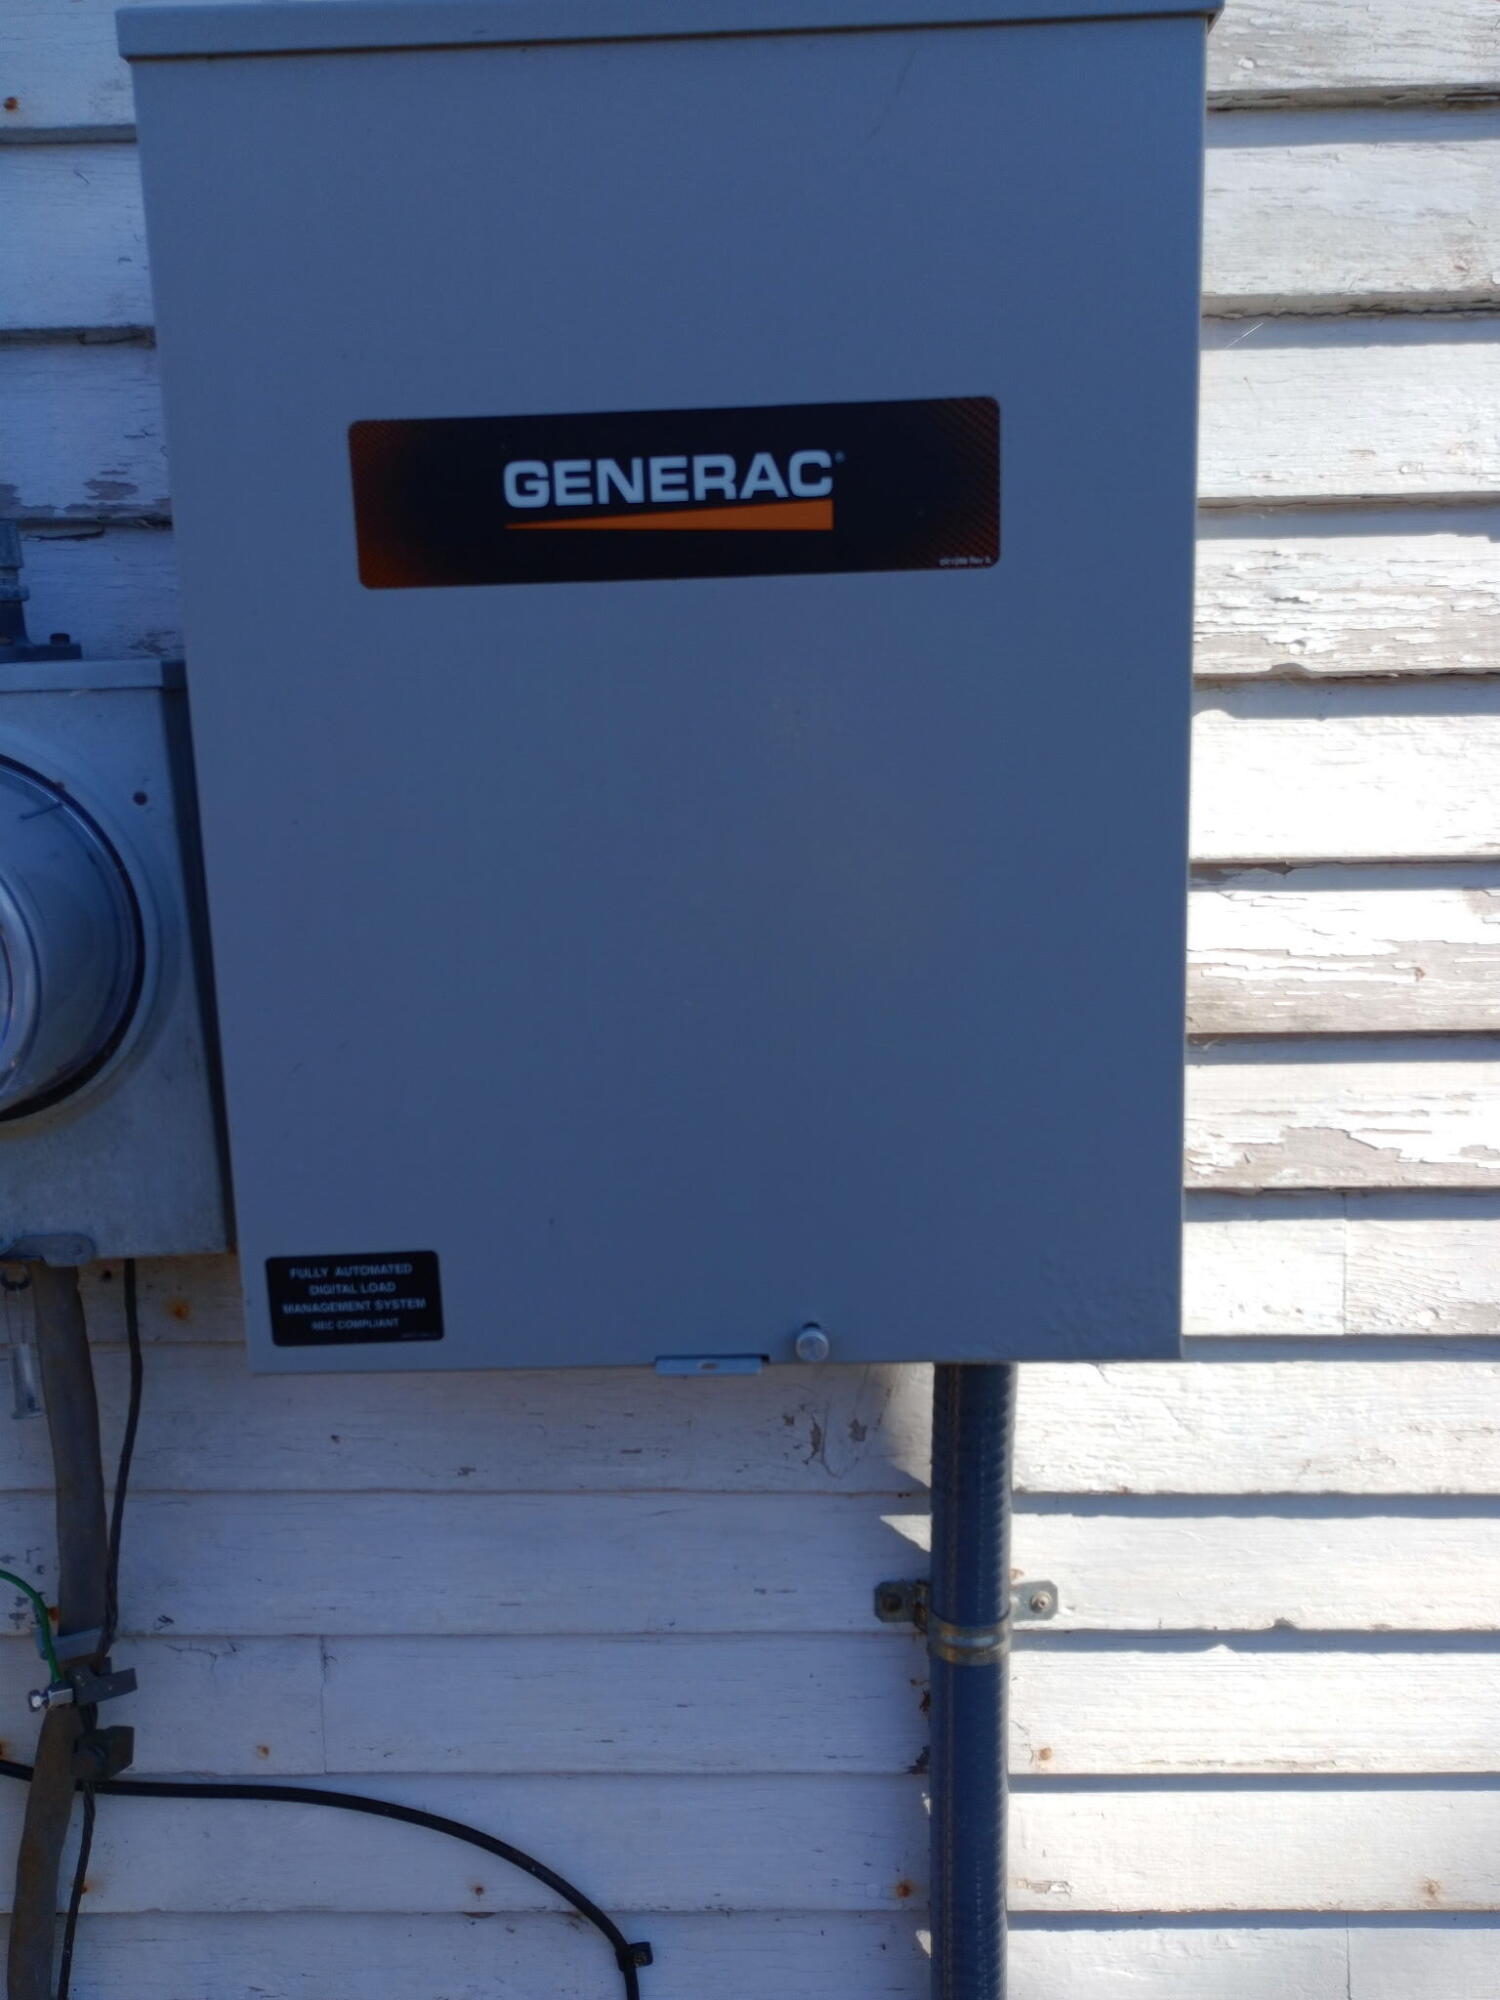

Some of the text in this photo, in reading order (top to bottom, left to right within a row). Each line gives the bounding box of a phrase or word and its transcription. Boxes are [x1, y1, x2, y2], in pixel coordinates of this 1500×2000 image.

[503, 449, 833, 508] GENERAC
[289, 1263, 412, 1279] FULLY AUTOMATED
[309, 1281, 396, 1296] DIGITAL LOAD
[282, 1298, 425, 1315] MANAGEMENT SYSTEM
[311, 1319, 398, 1331] NEC COMPLIANT
